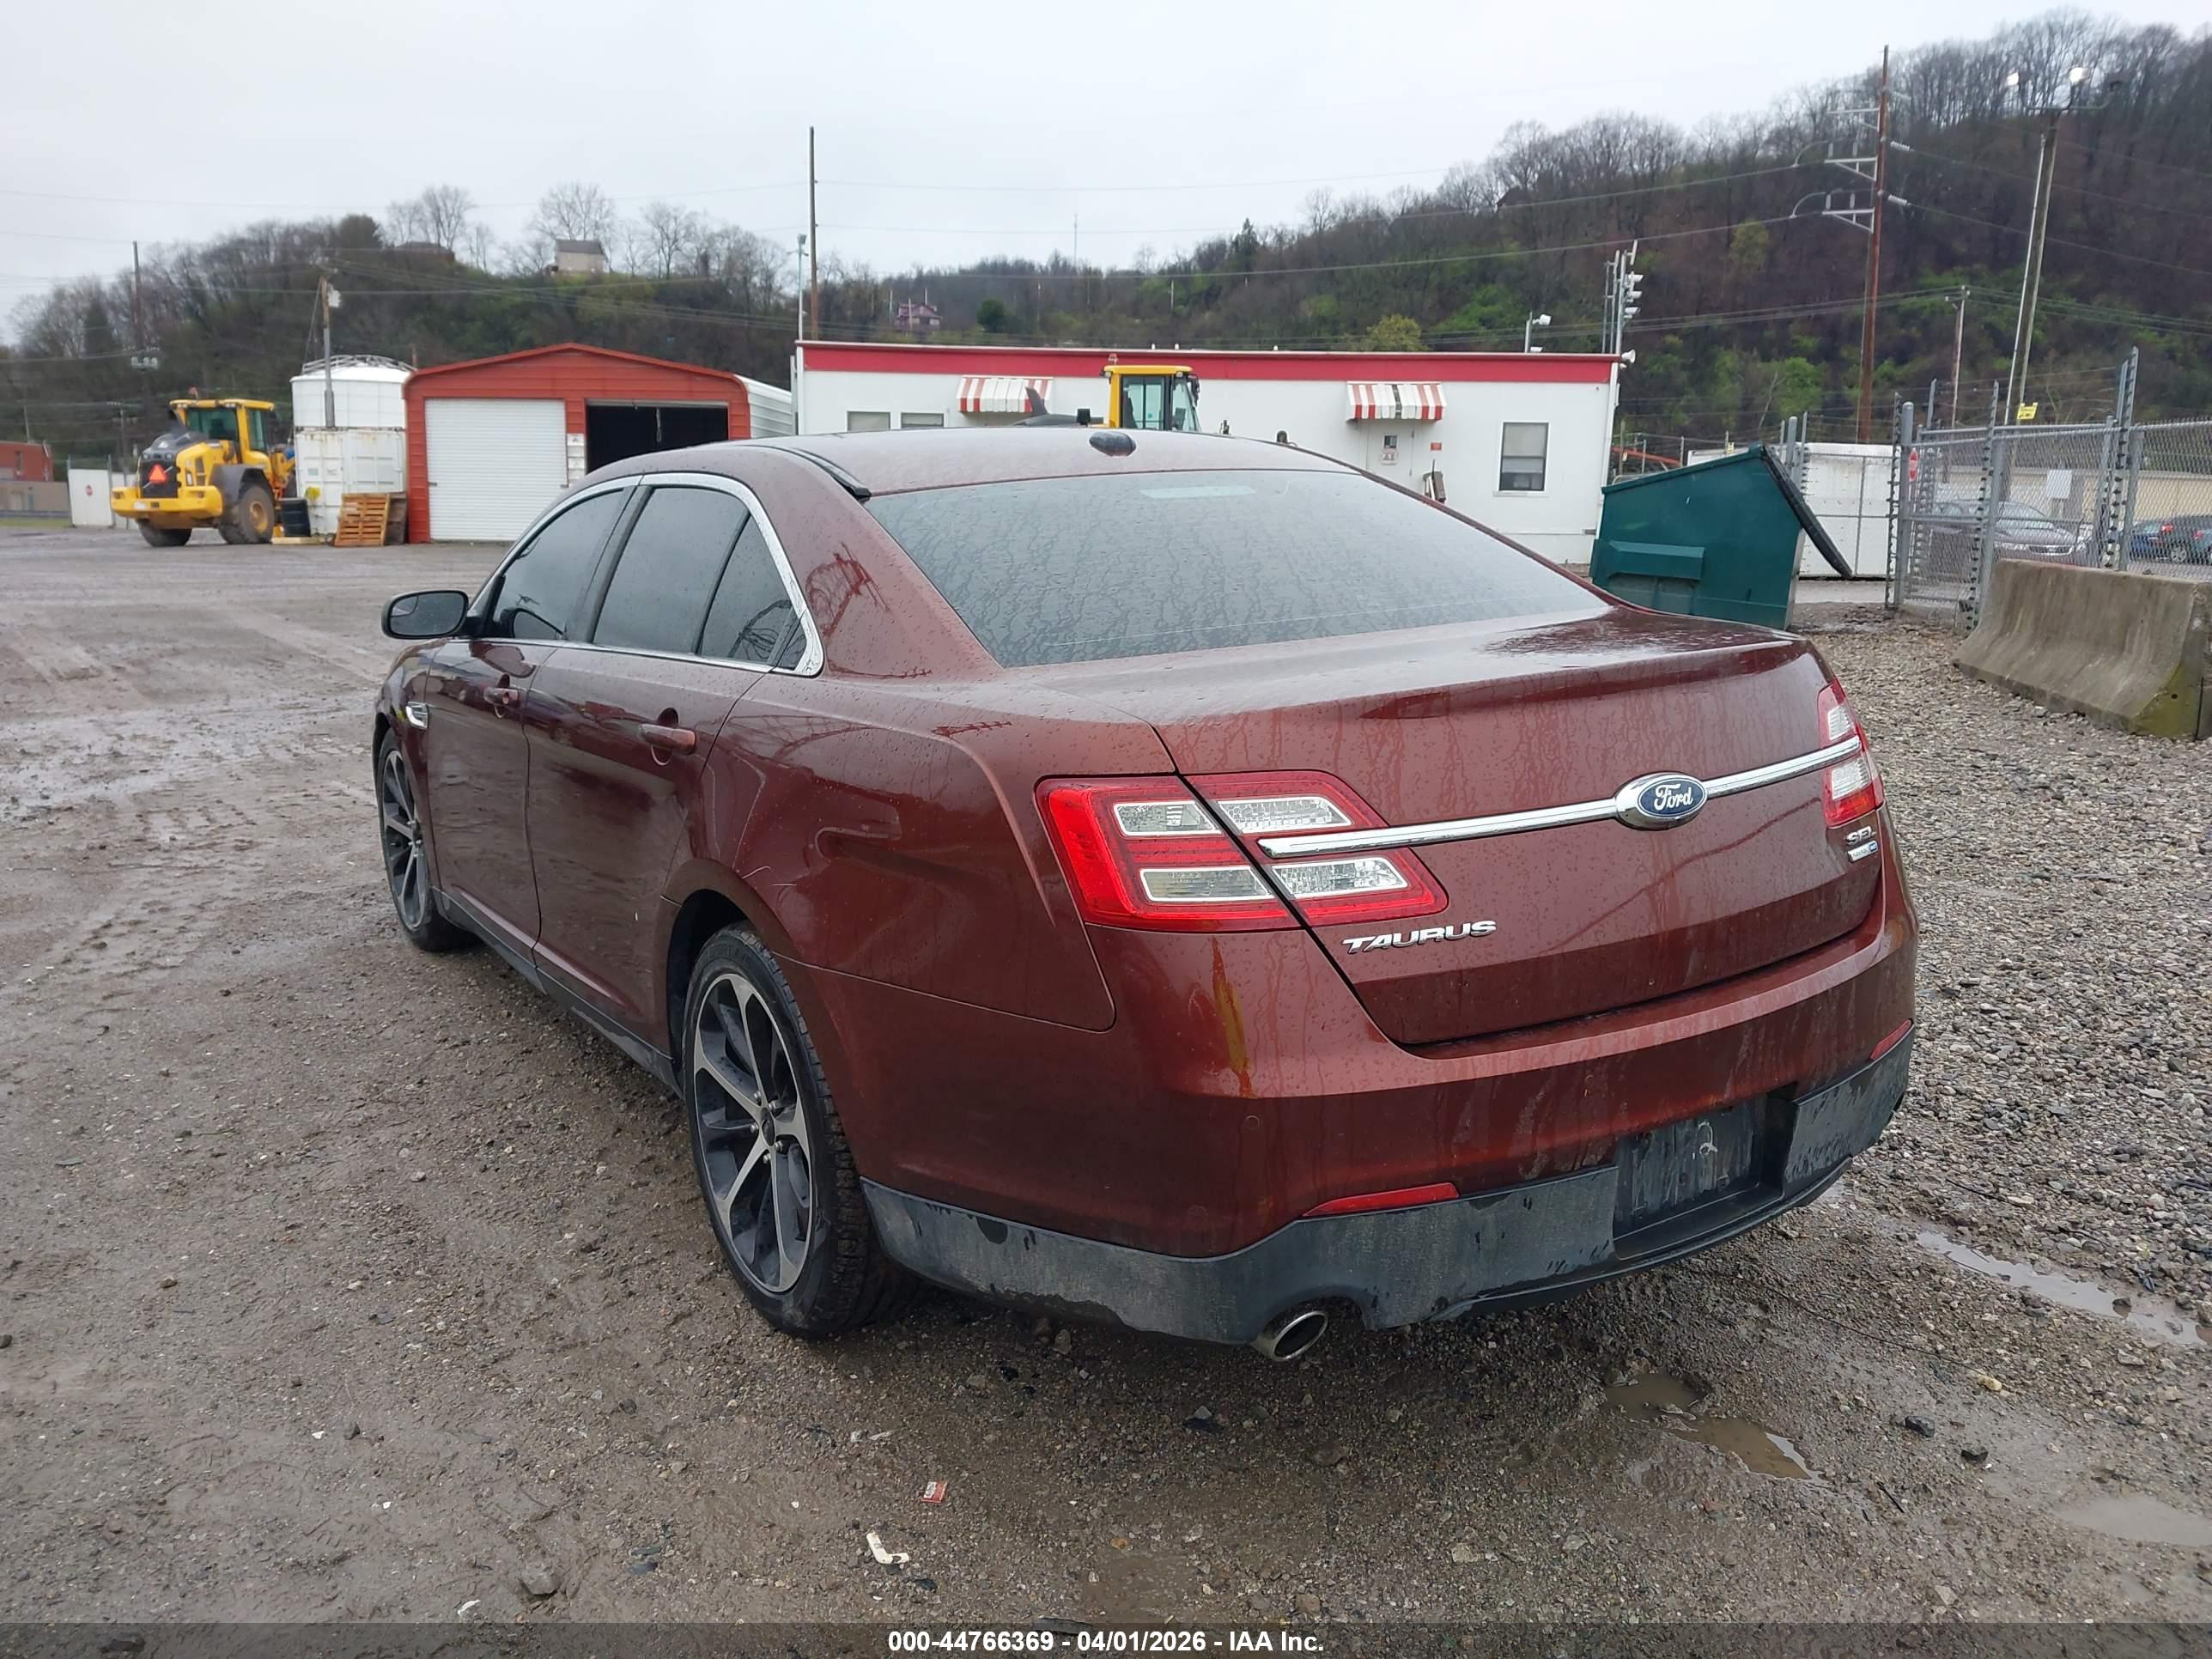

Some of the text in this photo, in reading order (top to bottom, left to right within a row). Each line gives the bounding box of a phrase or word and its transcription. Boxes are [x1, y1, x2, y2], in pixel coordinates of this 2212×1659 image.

[1653, 782, 1694, 811] Ford
[1846, 825, 1877, 846] SEL
[1342, 920, 1497, 954] TAURUS
